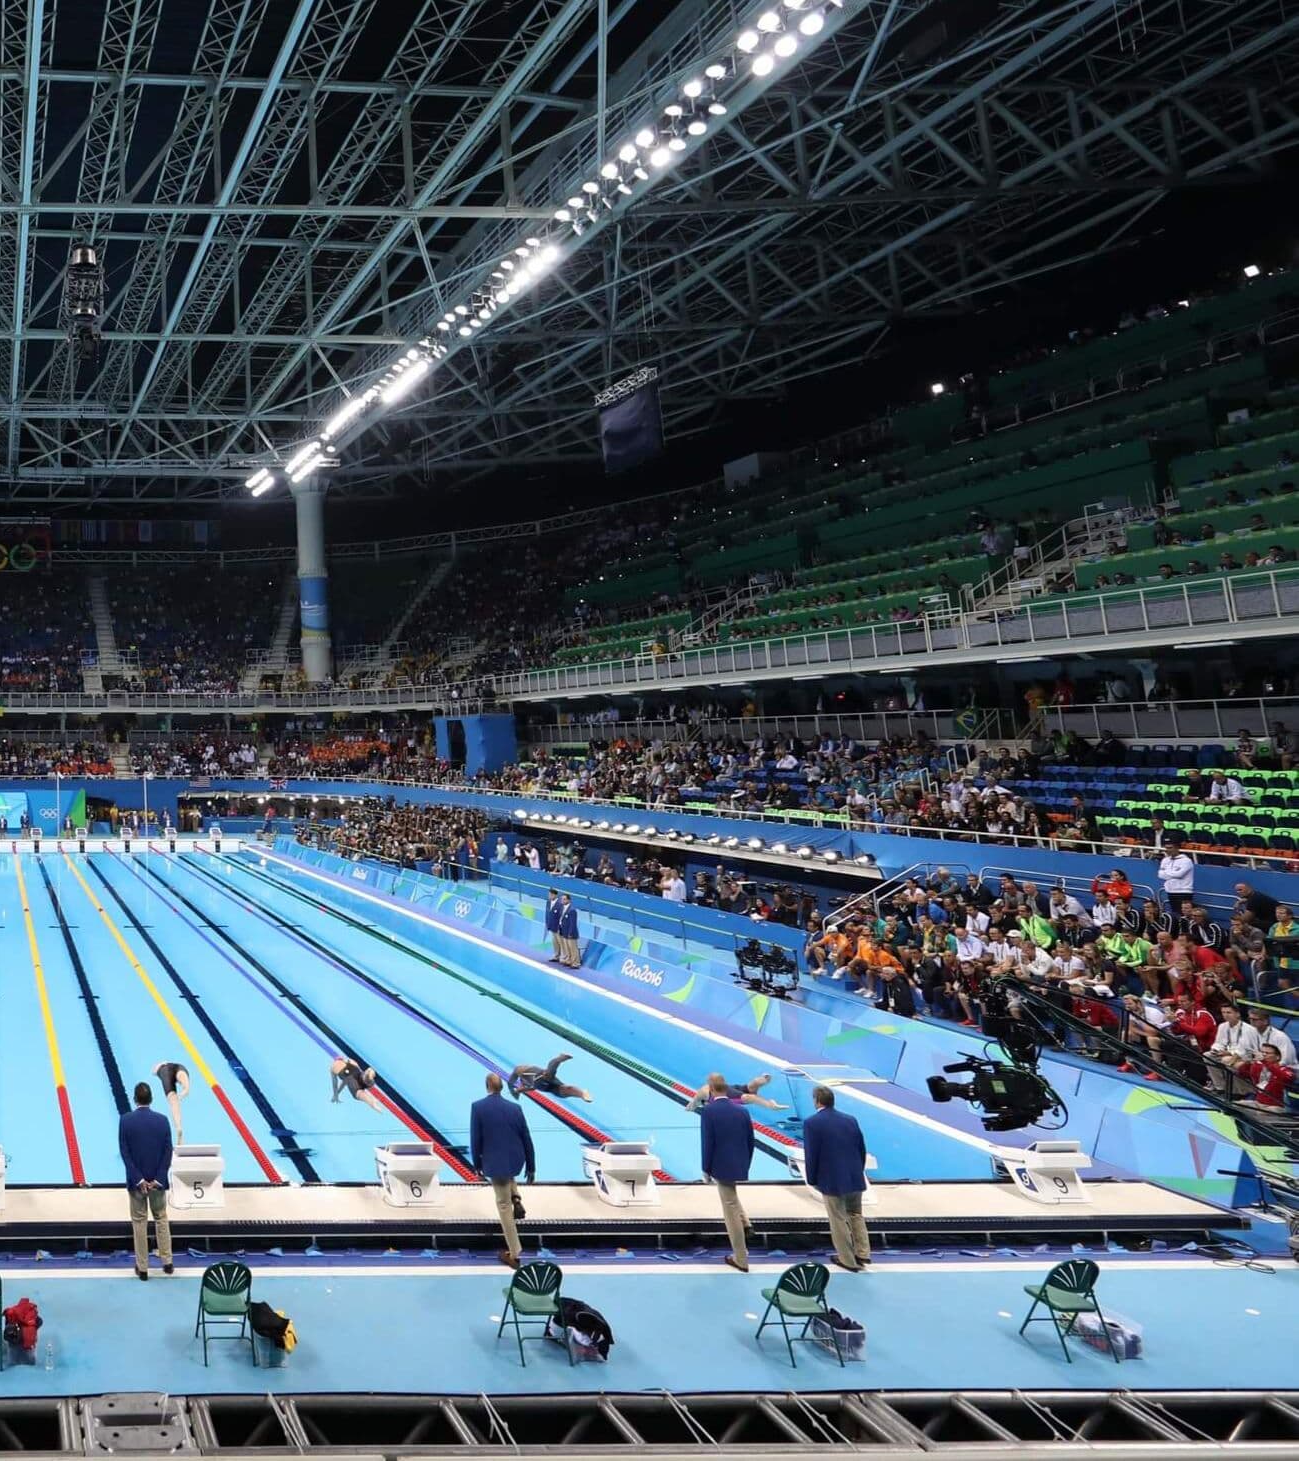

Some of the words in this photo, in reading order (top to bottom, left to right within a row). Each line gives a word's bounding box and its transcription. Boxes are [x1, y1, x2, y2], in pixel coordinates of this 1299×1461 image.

[1021, 1172, 1030, 1186] 9
[1052, 1176, 1069, 1194] 9
[193, 1181, 205, 1199] 5
[409, 1180, 423, 1198] 6
[624, 1180, 636, 1198] 7
